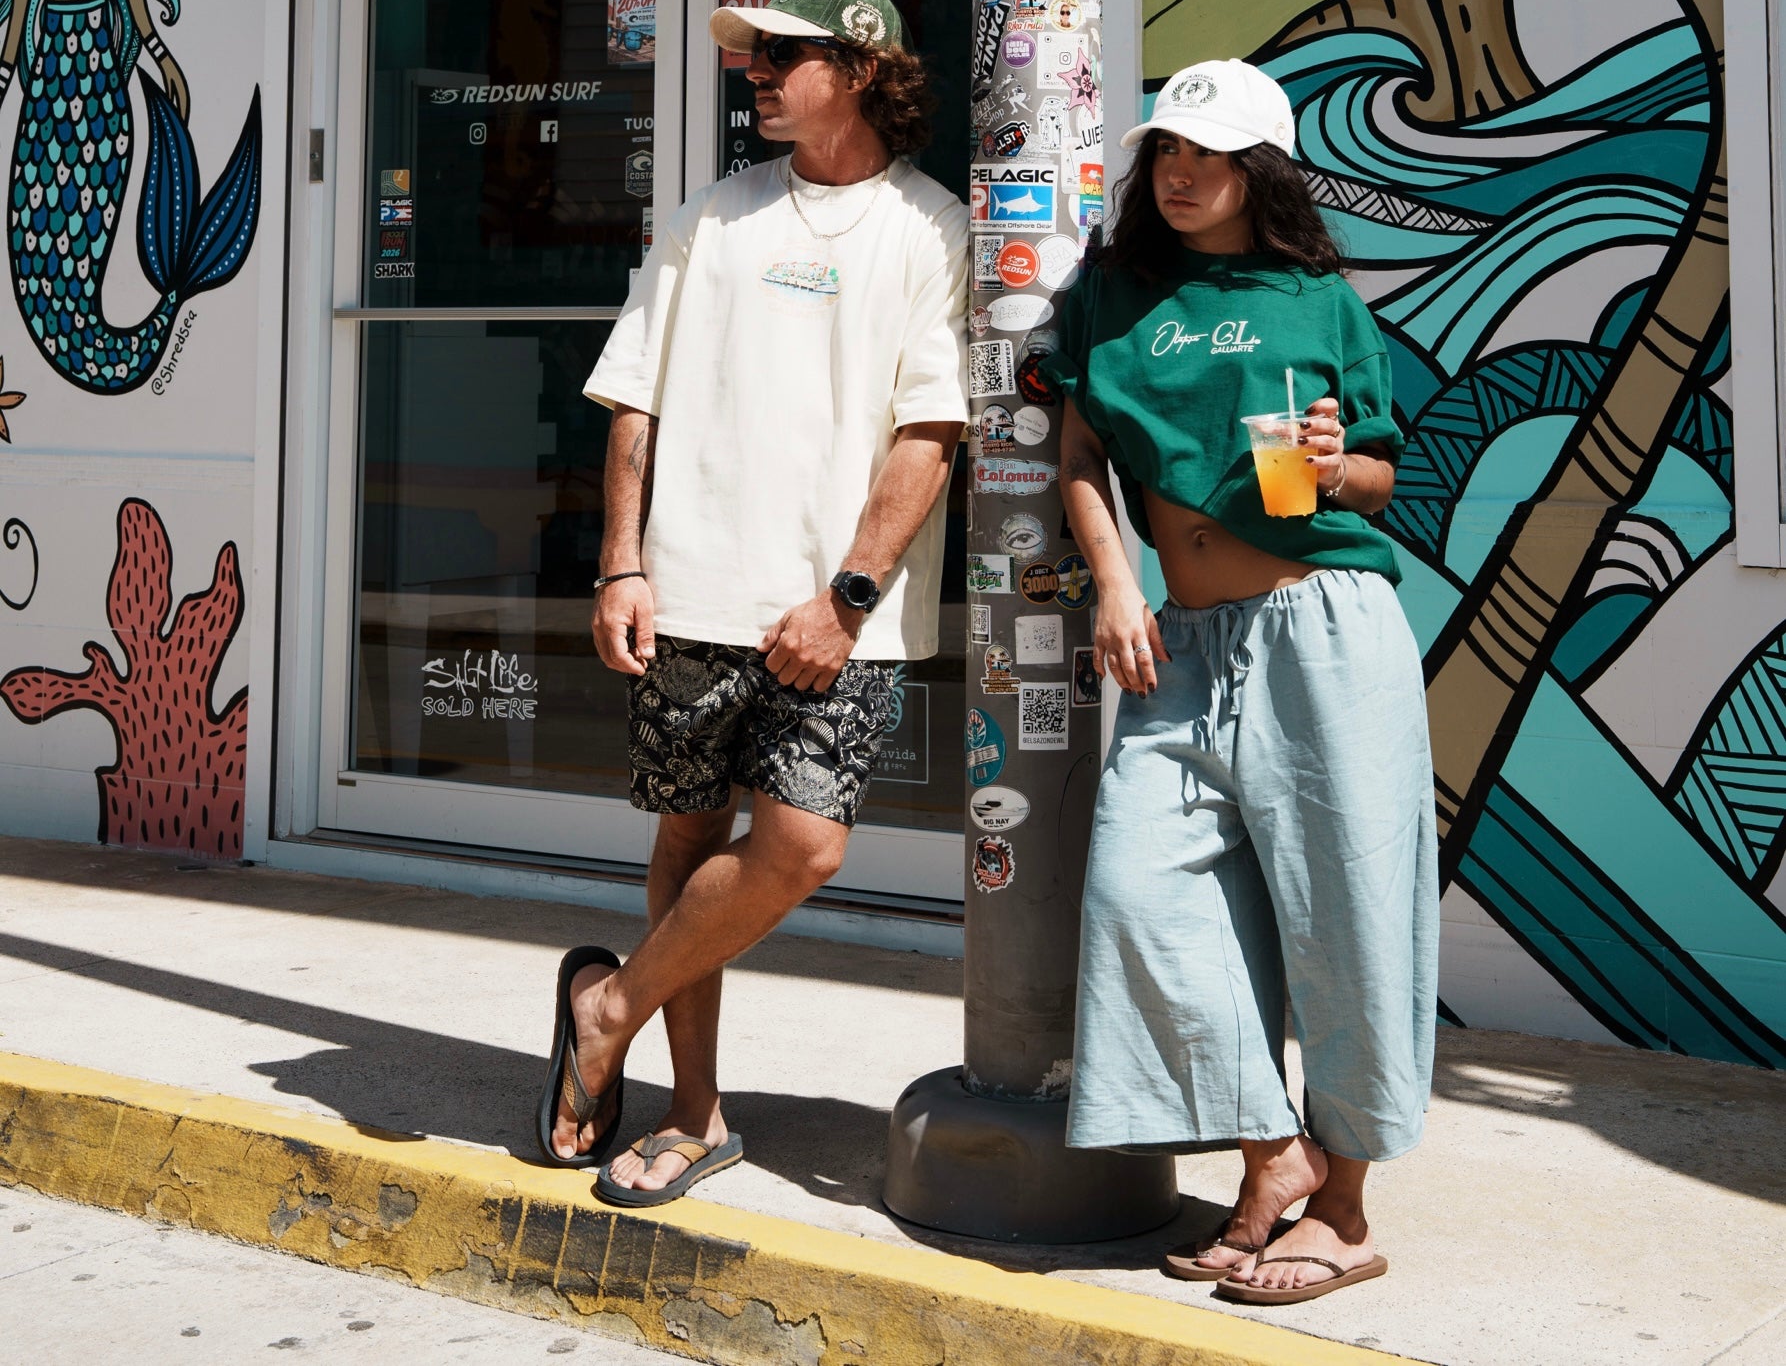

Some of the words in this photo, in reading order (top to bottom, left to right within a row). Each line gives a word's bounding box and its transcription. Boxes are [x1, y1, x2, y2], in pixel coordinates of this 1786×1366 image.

[462, 84, 548, 103] REDSUN
[550, 82, 602, 101] SURF
[971, 169, 1054, 183] PELAGIC
[381, 249, 400, 258] 2026
[374, 262, 415, 279] SHARK
[1001, 264, 1033, 277] REDSUN
[1210, 344, 1255, 355] GALUARTE
[1004, 342, 1014, 391] SNEAKERFEST
[976, 468, 1048, 483] Colonia
[1023, 575, 1060, 594] 3000
[421, 696, 474, 718] SOLD
[482, 697, 538, 720] HERE
